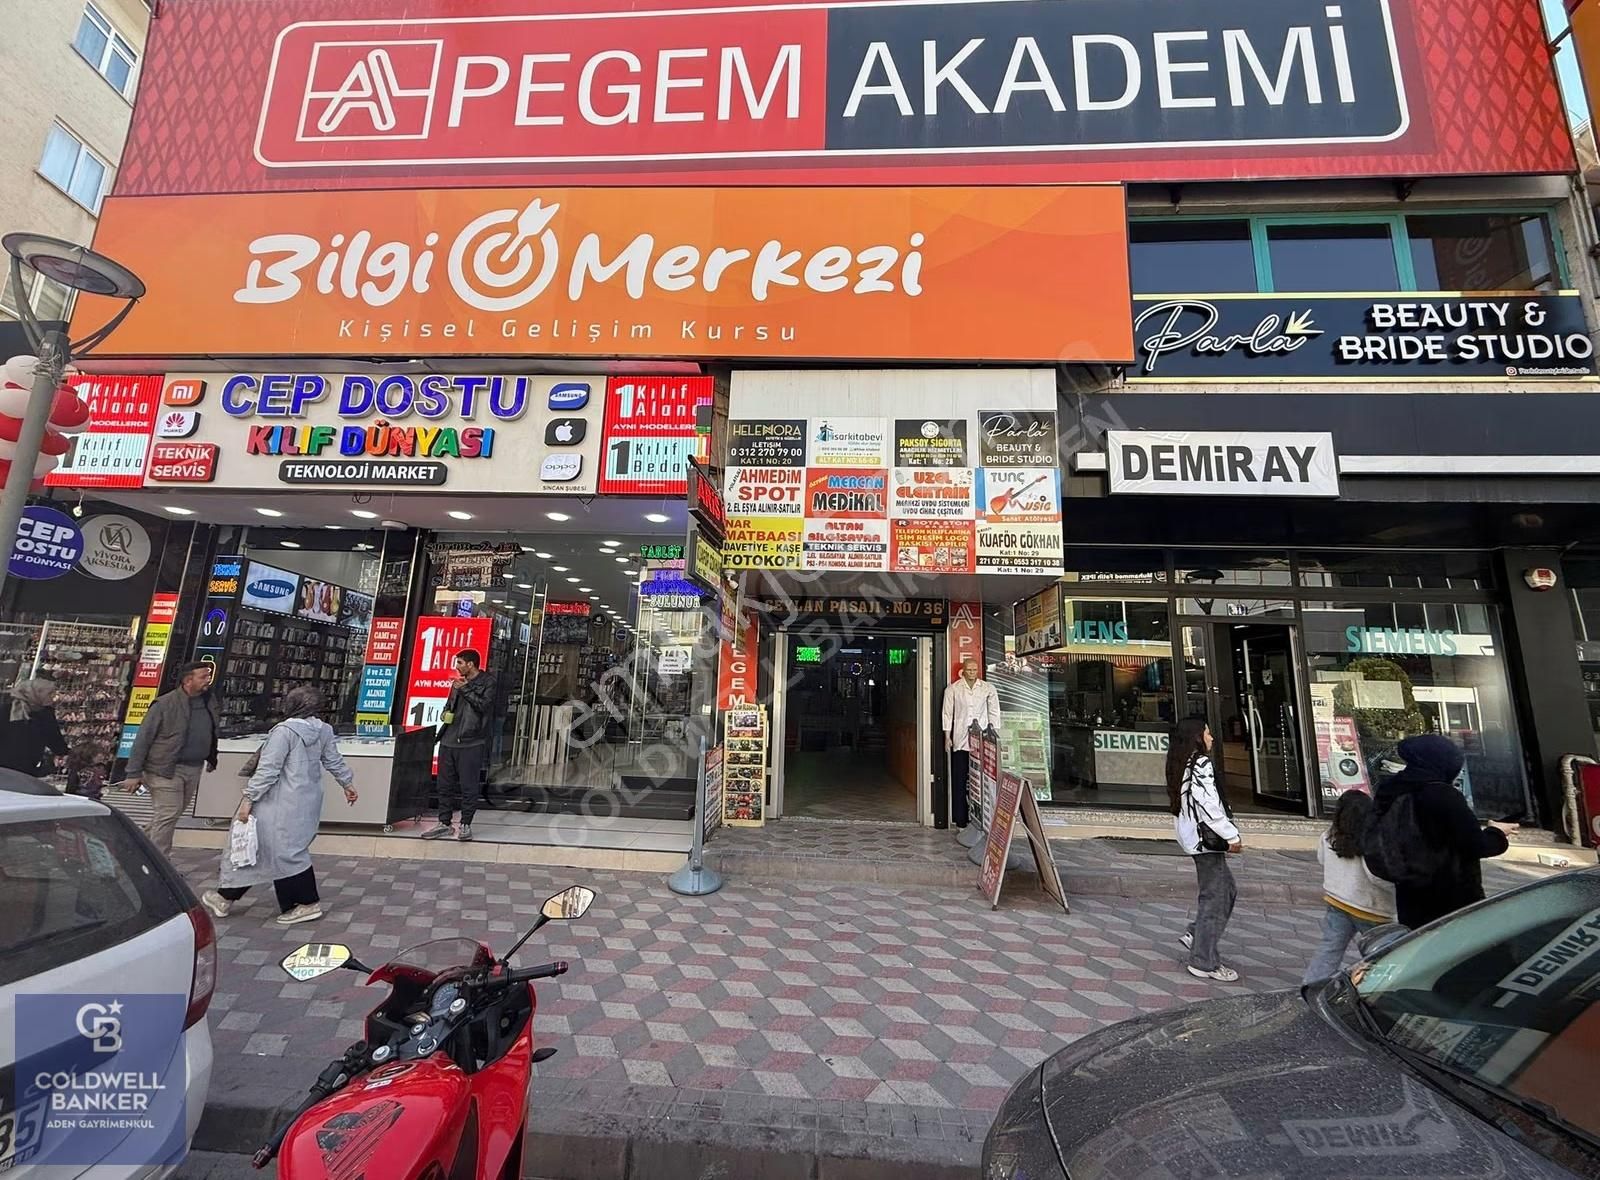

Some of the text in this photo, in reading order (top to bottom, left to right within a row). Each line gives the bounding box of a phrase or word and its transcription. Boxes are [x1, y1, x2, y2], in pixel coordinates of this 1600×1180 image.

[447, 4, 1356, 128] PEGEM AKADEMİ
[234, 229, 925, 307] Bilgi Merkezi
[1371, 301, 1547, 328] BEAUTY &
[338, 319, 796, 343] Kişisel Gelişim Kursu
[1134, 299, 1308, 372] Parla
[1338, 334, 1594, 361] BRIDE STUDIO
[92, 382, 140, 398] Kılıf
[220, 374, 532, 419] CEP DOSTU
[88, 399, 149, 414] Alana
[615, 383, 688, 418] 1 Kılıf
[982, 414, 1049, 446] Parla
[82, 438, 121, 451] Kılıf
[247, 419, 496, 458] KILIF DÜNYASI
[899, 436, 962, 448] PAKSOY SİGORTA
[157, 445, 211, 460] TEKNİK
[731, 448, 803, 457] 0 312 270 79 00
[996, 443, 1042, 452] BEAUTY &
[78, 454, 143, 469] Bedava
[610, 440, 678, 475] 1 Kılıf
[985, 455, 1053, 464] BRIDE STUDIO
[153, 461, 206, 477] SERVİS
[285, 461, 439, 481] TEKNOLOJİ MARKET
[828, 474, 884, 489] MERCAN
[913, 471, 953, 485] UZEL
[738, 485, 800, 502] SPOT
[726, 502, 732, 513] 2.
[733, 503, 740, 513] EL
[742, 503, 757, 516] EŞYA
[726, 520, 751, 529] NAR
[824, 521, 865, 531] ALTAN
[726, 530, 802, 542] MATBAASI
[979, 530, 1060, 550] KUAFÖR GÖKHAN
[724, 541, 801, 555] DAVETİYE KAŞE
[25, 555, 72, 571] DÜNYASI
[723, 553, 800, 567] FOTOKOPİ
[979, 557, 991, 565] 271
[252, 580, 290, 596] SAMSUNG
[923, 602, 944, 615] 36
[1345, 625, 1458, 656] SIEMENS
[420, 626, 473, 672] 1 Kılıf
[414, 679, 432, 688] AYNI
[410, 702, 425, 726] 1
[1093, 731, 1170, 751] SIEMENS
